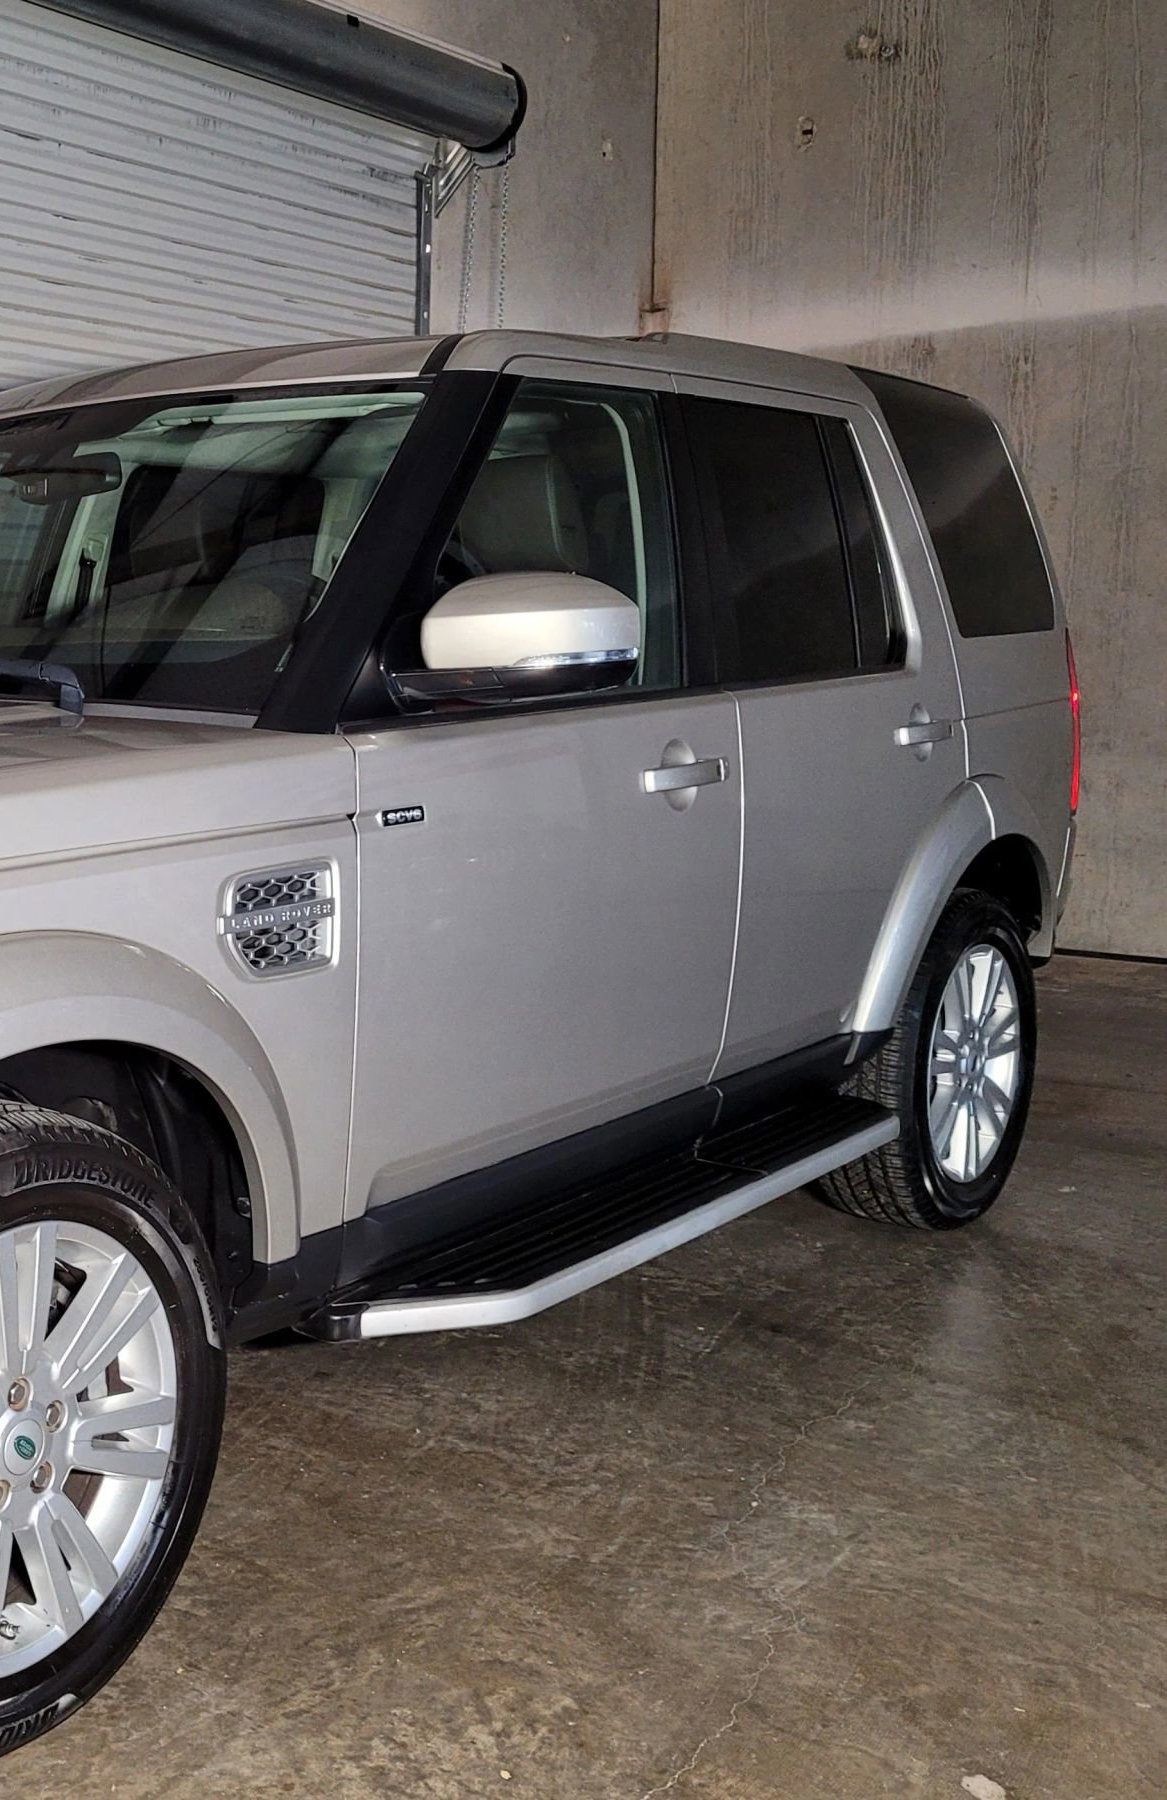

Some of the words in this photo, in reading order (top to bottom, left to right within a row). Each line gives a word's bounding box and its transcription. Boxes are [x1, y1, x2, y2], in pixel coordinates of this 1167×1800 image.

[386, 808, 422, 824] SCV6
[231, 913, 274, 929] LAND
[281, 903, 332, 920] ROVER
[12, 1156, 156, 1209] BRIDGESTONE
